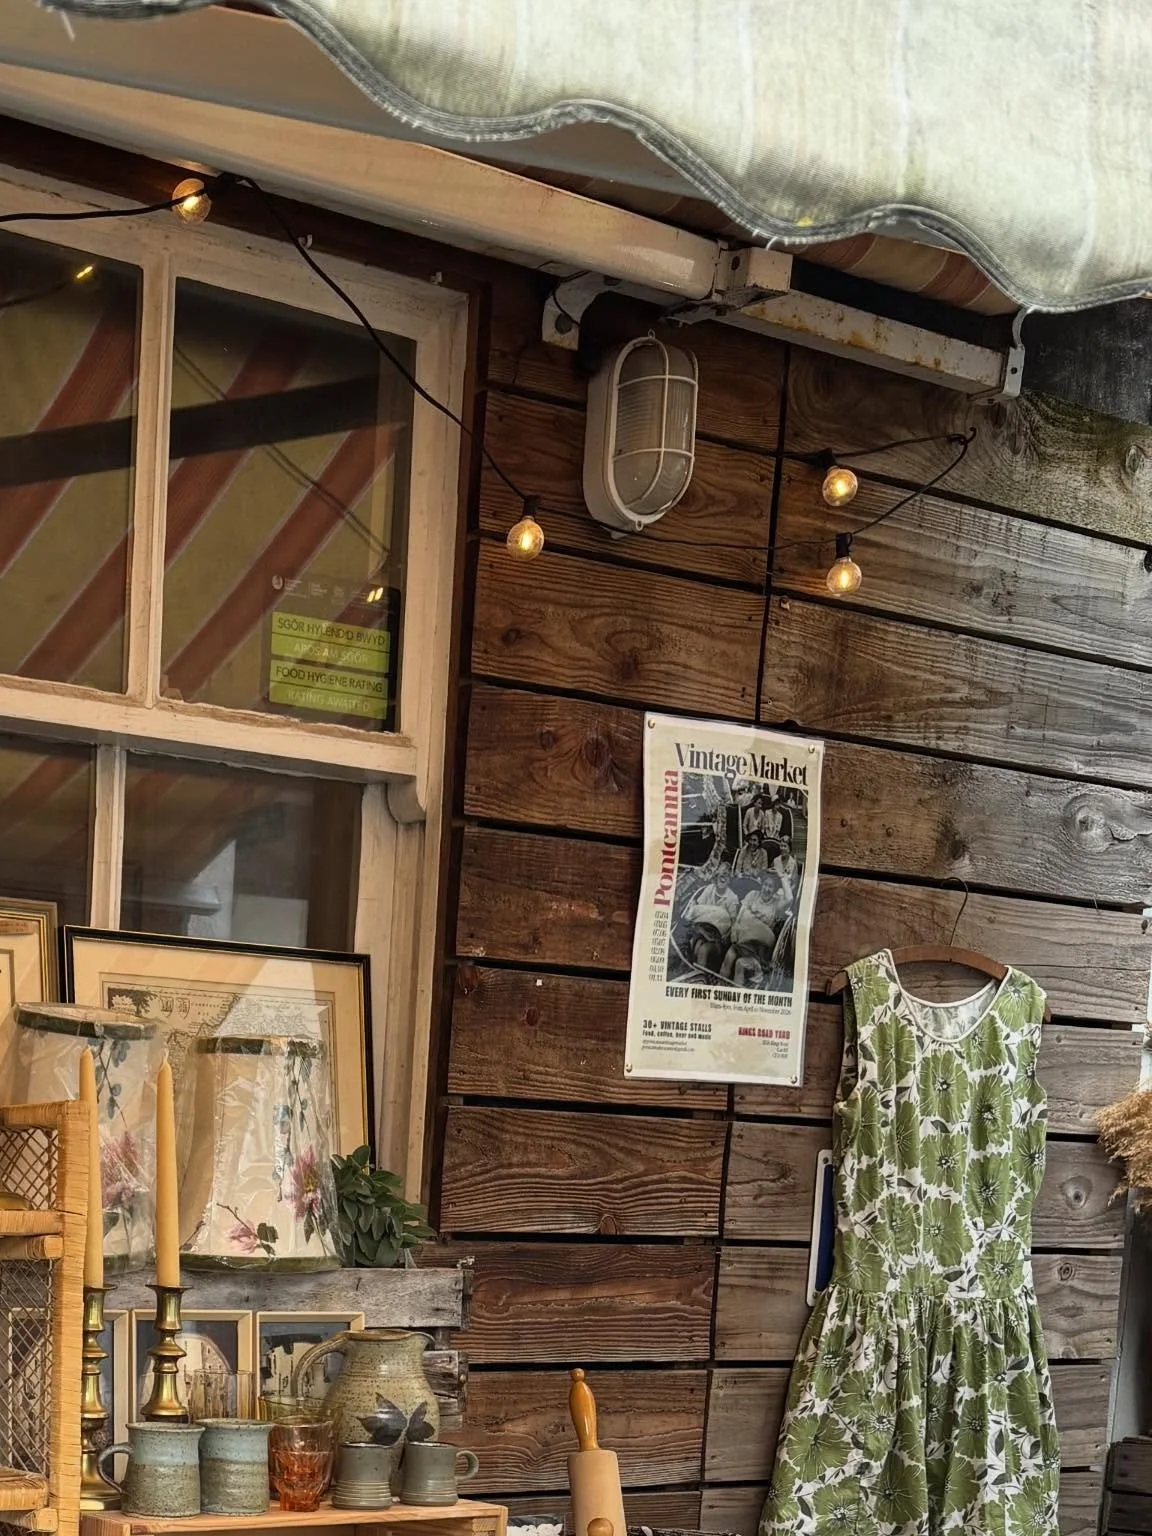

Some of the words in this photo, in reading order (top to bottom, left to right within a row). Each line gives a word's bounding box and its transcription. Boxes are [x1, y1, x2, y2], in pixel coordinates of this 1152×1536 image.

[356, 632, 385, 646] BWYD
[276, 666, 305, 679] FOOD
[308, 671, 348, 687] HYGIENE
[350, 678, 383, 693] RATING
[288, 689, 324, 705] RATING
[675, 743, 747, 780] Vintage
[749, 753, 808, 785] Market
[654, 770, 678, 905] Pontcanna
[665, 986, 689, 998] EVERY
[691, 988, 712, 1000] FIRST
[714, 990, 741, 1003] SUNDAY
[743, 993, 752, 1004] OF
[754, 994, 765, 1005] THE
[768, 995, 792, 1008] MONTH
[643, 1020, 657, 1029] 30+
[660, 1021, 688, 1031] VINTAGE
[690, 1023, 712, 1032] STALLS
